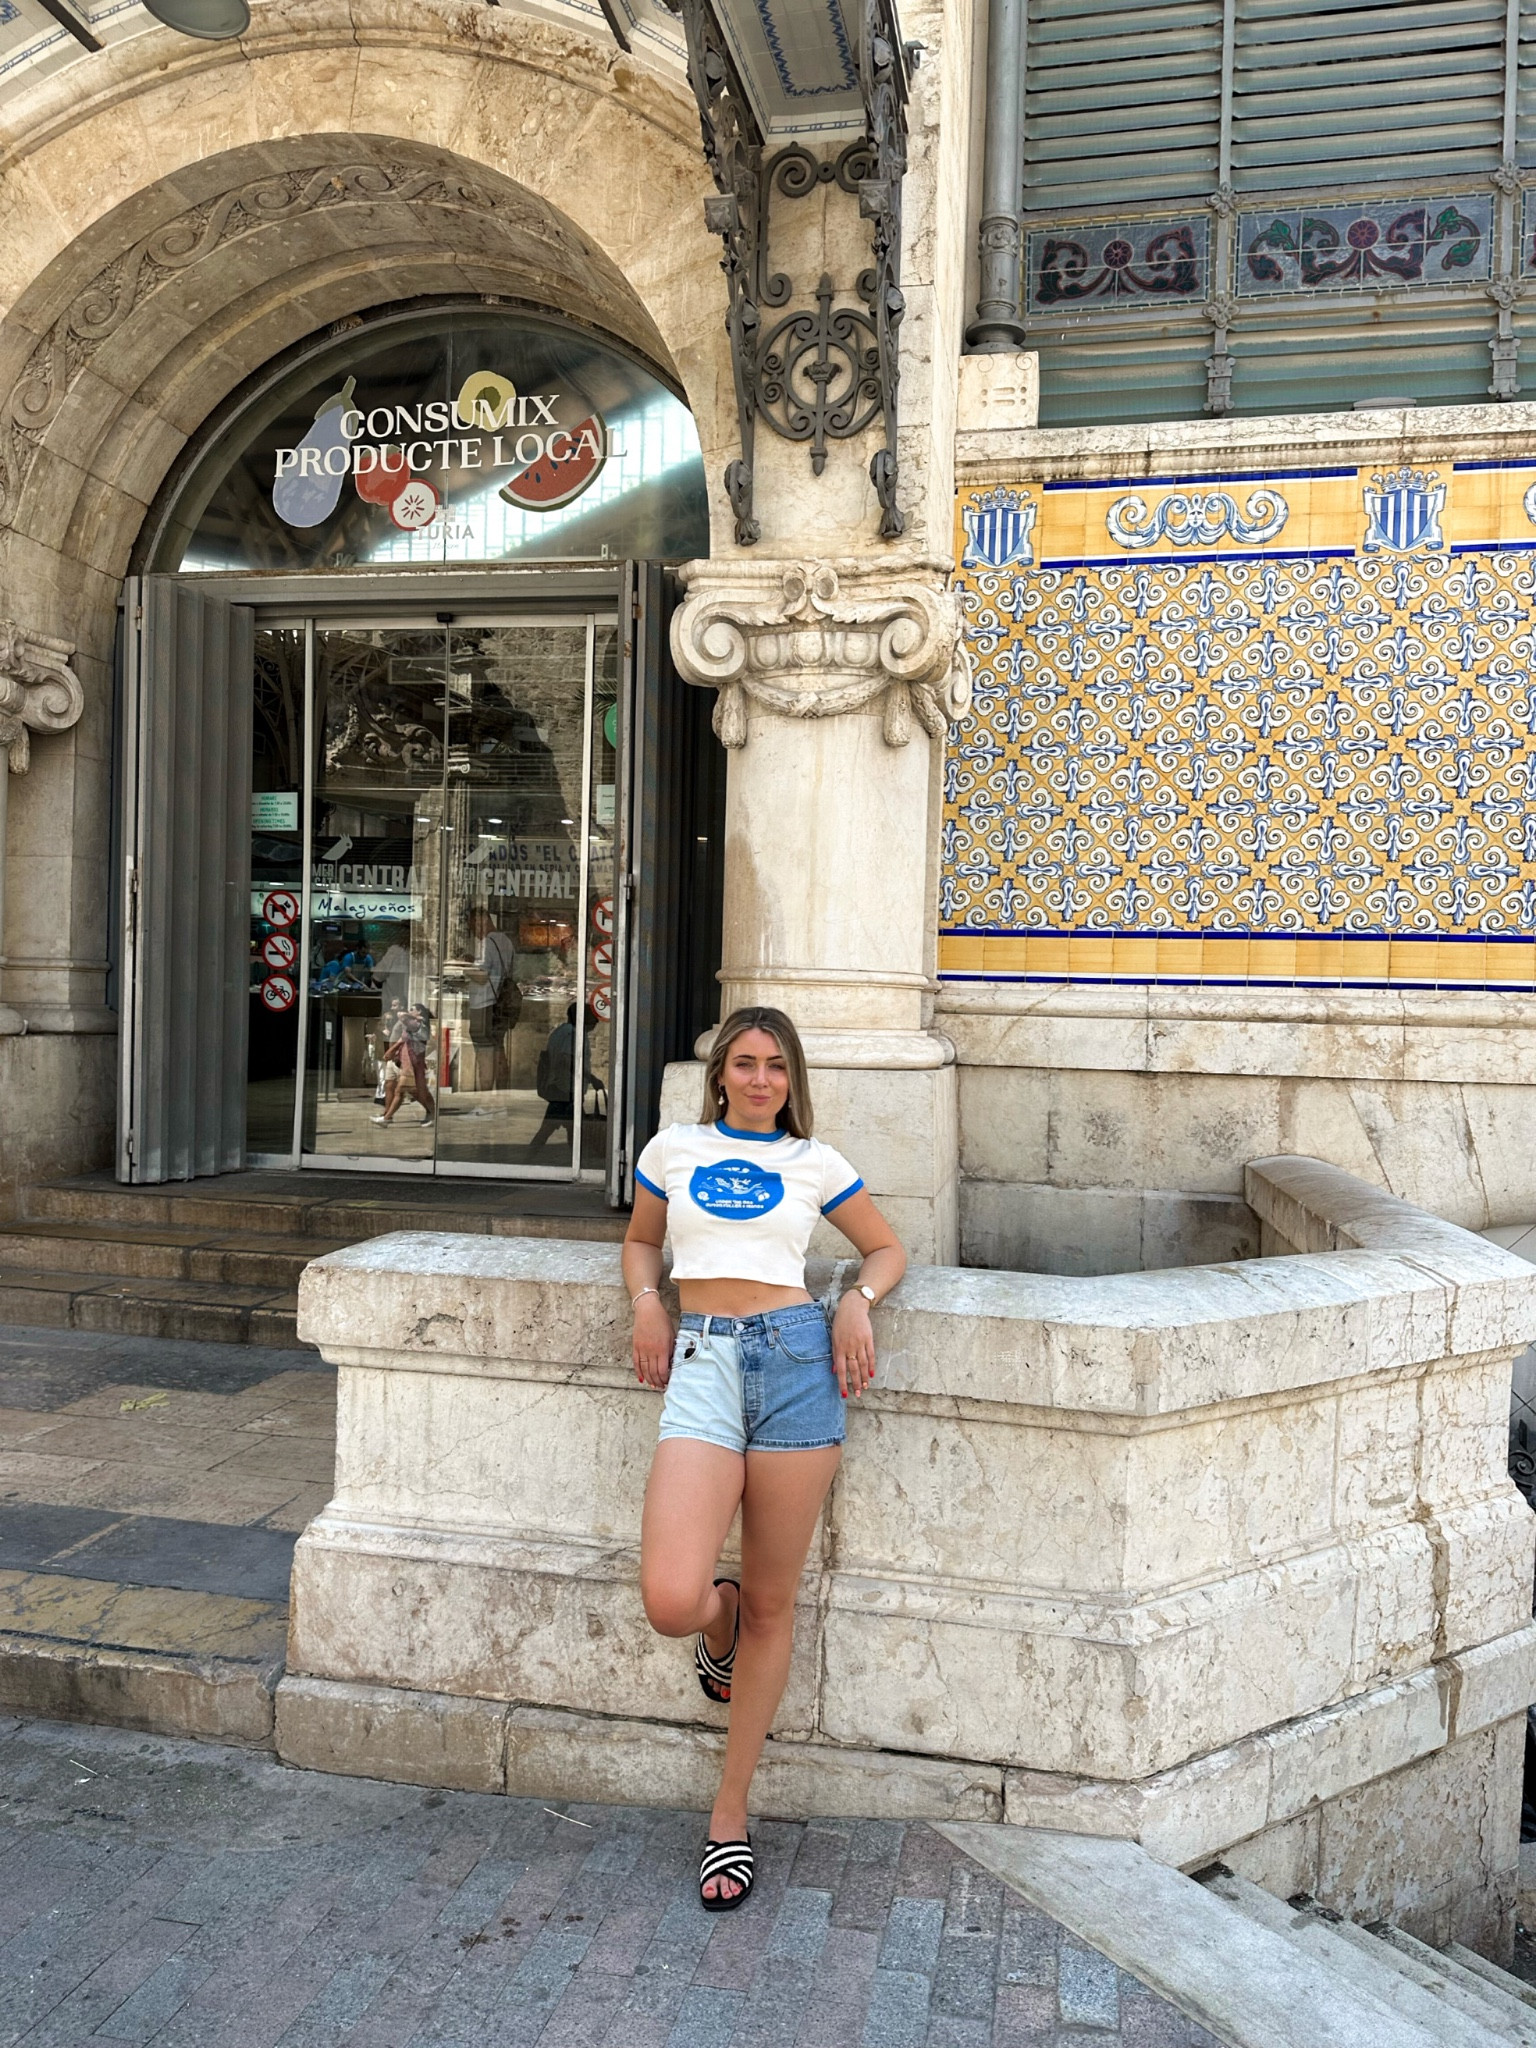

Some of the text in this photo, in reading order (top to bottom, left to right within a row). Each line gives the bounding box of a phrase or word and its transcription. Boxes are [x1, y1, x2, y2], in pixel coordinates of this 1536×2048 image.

[340, 394, 560, 440] CONSUMIX
[274, 428, 628, 478] PRODUCTE LOCAL
[418, 524, 475, 541] TURIA
[480, 868, 575, 899] CENTRAL
[317, 896, 416, 919] Malagueños
